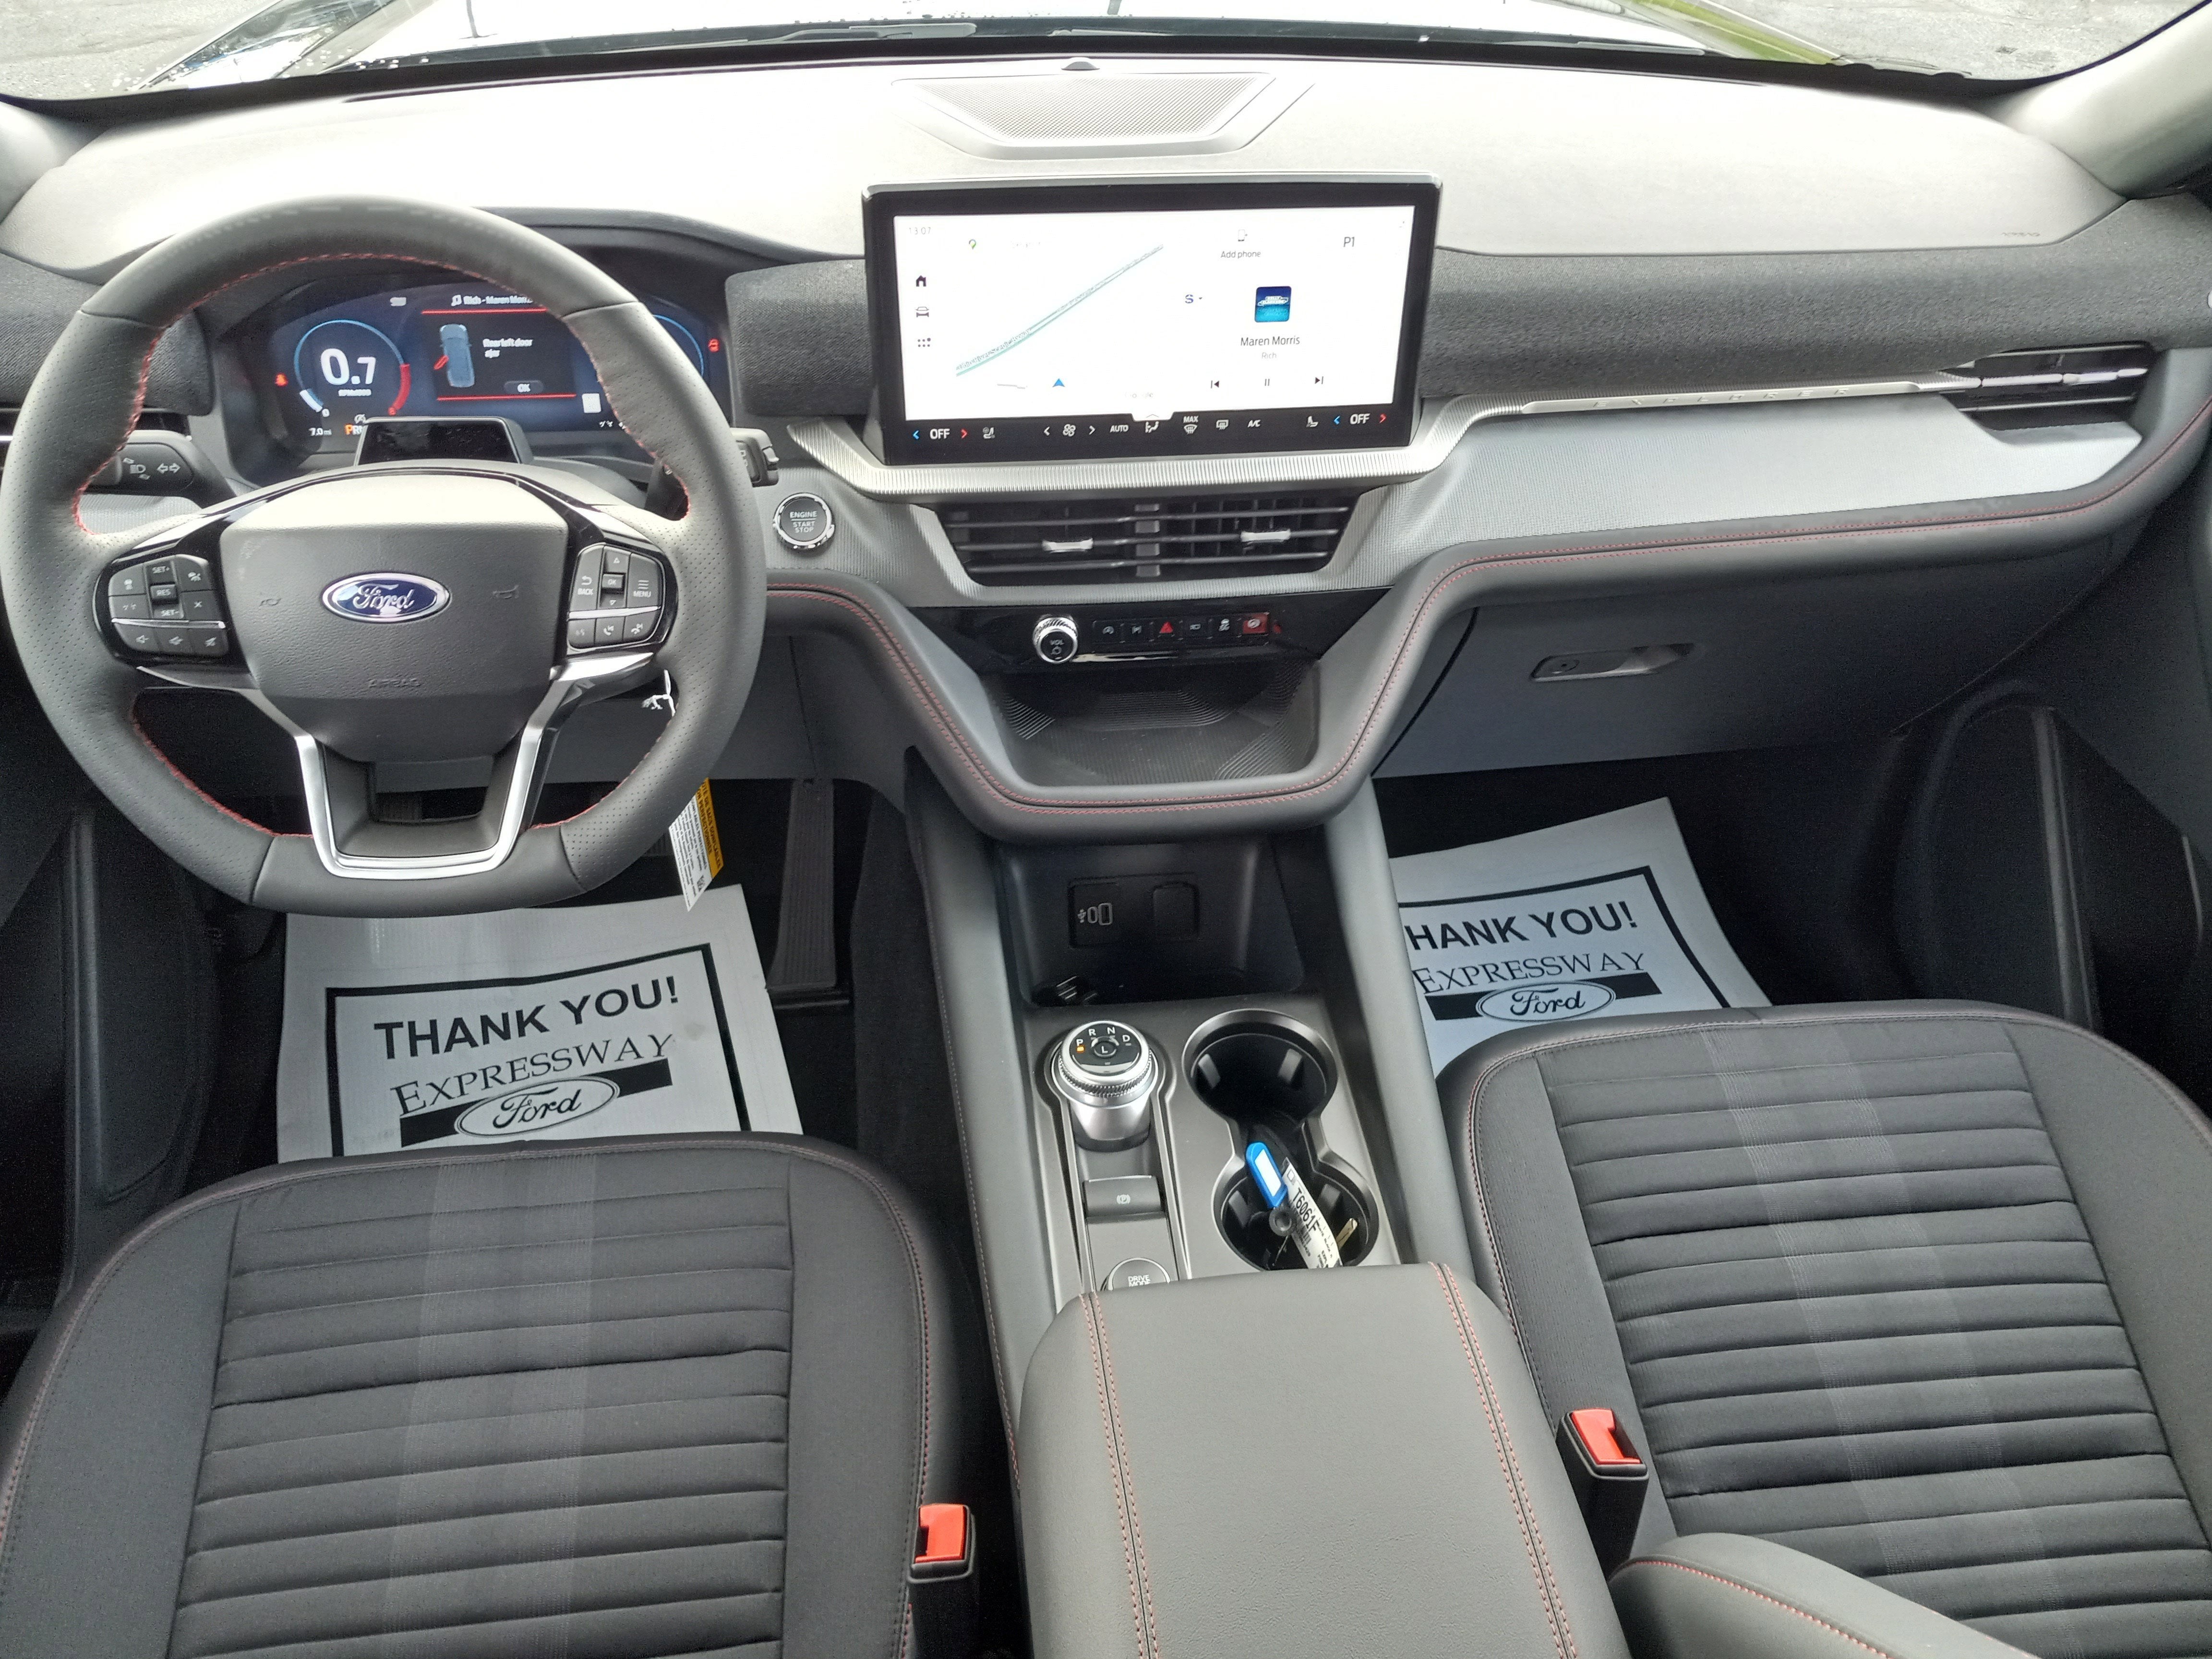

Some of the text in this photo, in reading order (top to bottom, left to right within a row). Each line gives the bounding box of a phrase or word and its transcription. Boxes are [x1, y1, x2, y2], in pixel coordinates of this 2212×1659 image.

[1238, 250, 1261, 259] phone
[1343, 237, 1355, 247] P1
[1240, 336, 1300, 346] Maren Morris
[321, 348, 376, 385] 0.7
[1110, 424, 1129, 433] AUTO
[1350, 413, 1370, 424] OFF
[929, 428, 950, 440] OFF
[352, 583, 414, 609] Ford
[1405, 901, 1637, 950] HANK YOU!
[1411, 952, 1645, 994] EXPRESSWAY
[1511, 988, 1586, 1016] Ford
[374, 975, 678, 1059] THANK YOU!
[391, 1034, 673, 1116] EXPRESSWAY
[492, 1088, 582, 1129] Ford
[1293, 1188, 1320, 1232] T6061F
